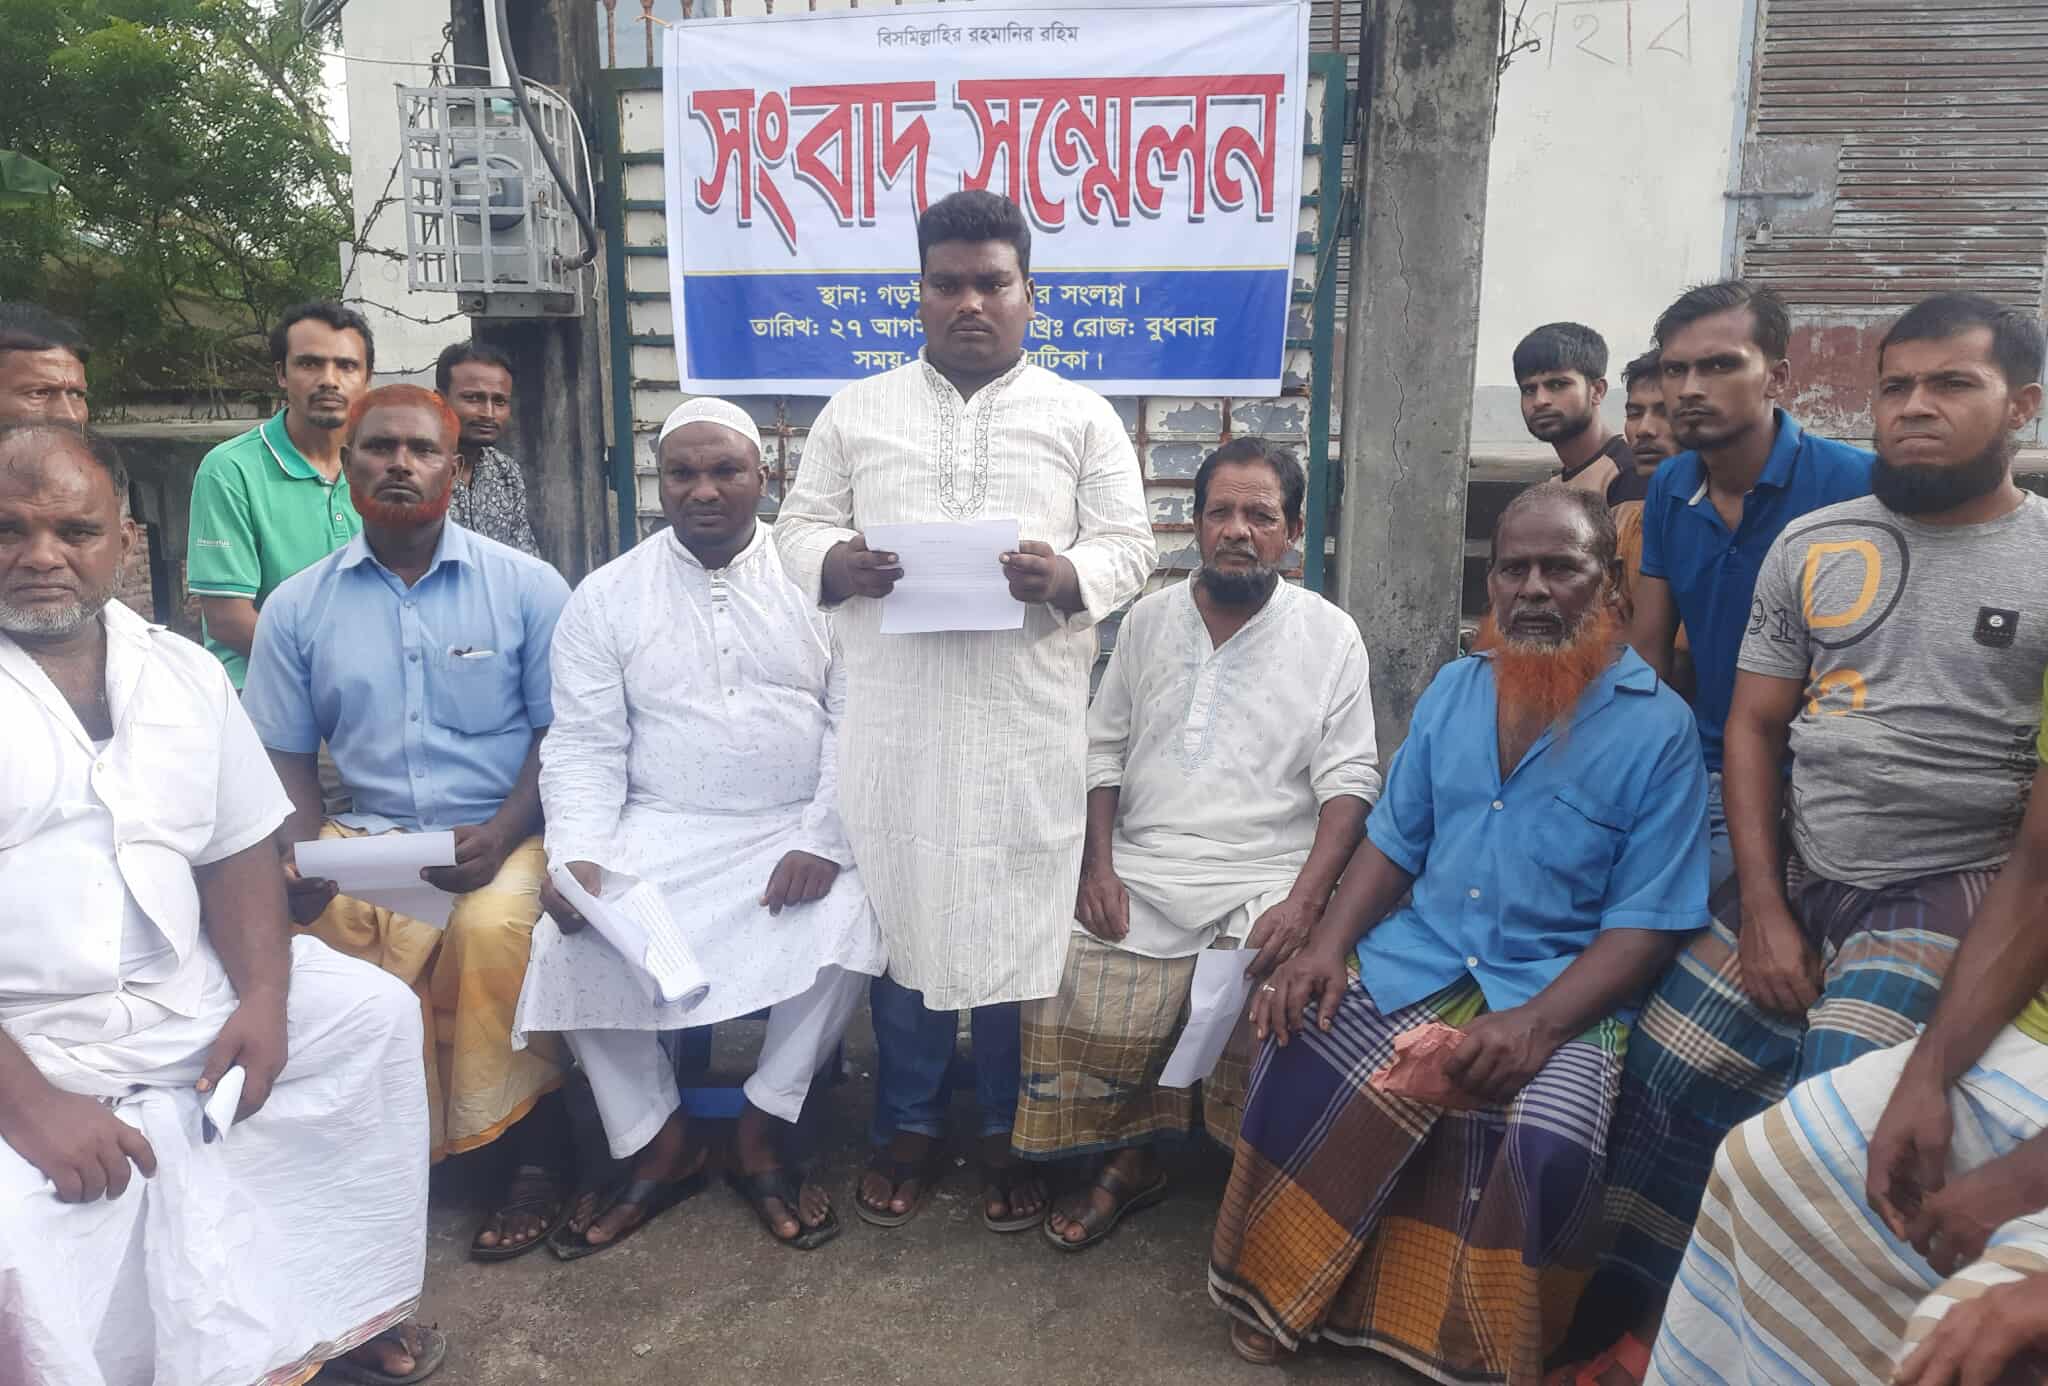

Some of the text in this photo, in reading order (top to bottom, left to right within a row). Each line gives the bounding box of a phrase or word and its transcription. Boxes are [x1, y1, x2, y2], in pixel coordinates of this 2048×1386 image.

[877, 20, 1080, 48] বিসমিল্লাহির রহমানির রহিম
[688, 73, 1287, 256] সংবাদ সম্মেলন
[1059, 282, 1127, 308] সংলগ্ন
[829, 319, 864, 340] ২৭
[1144, 315, 1218, 343] বুধবার
